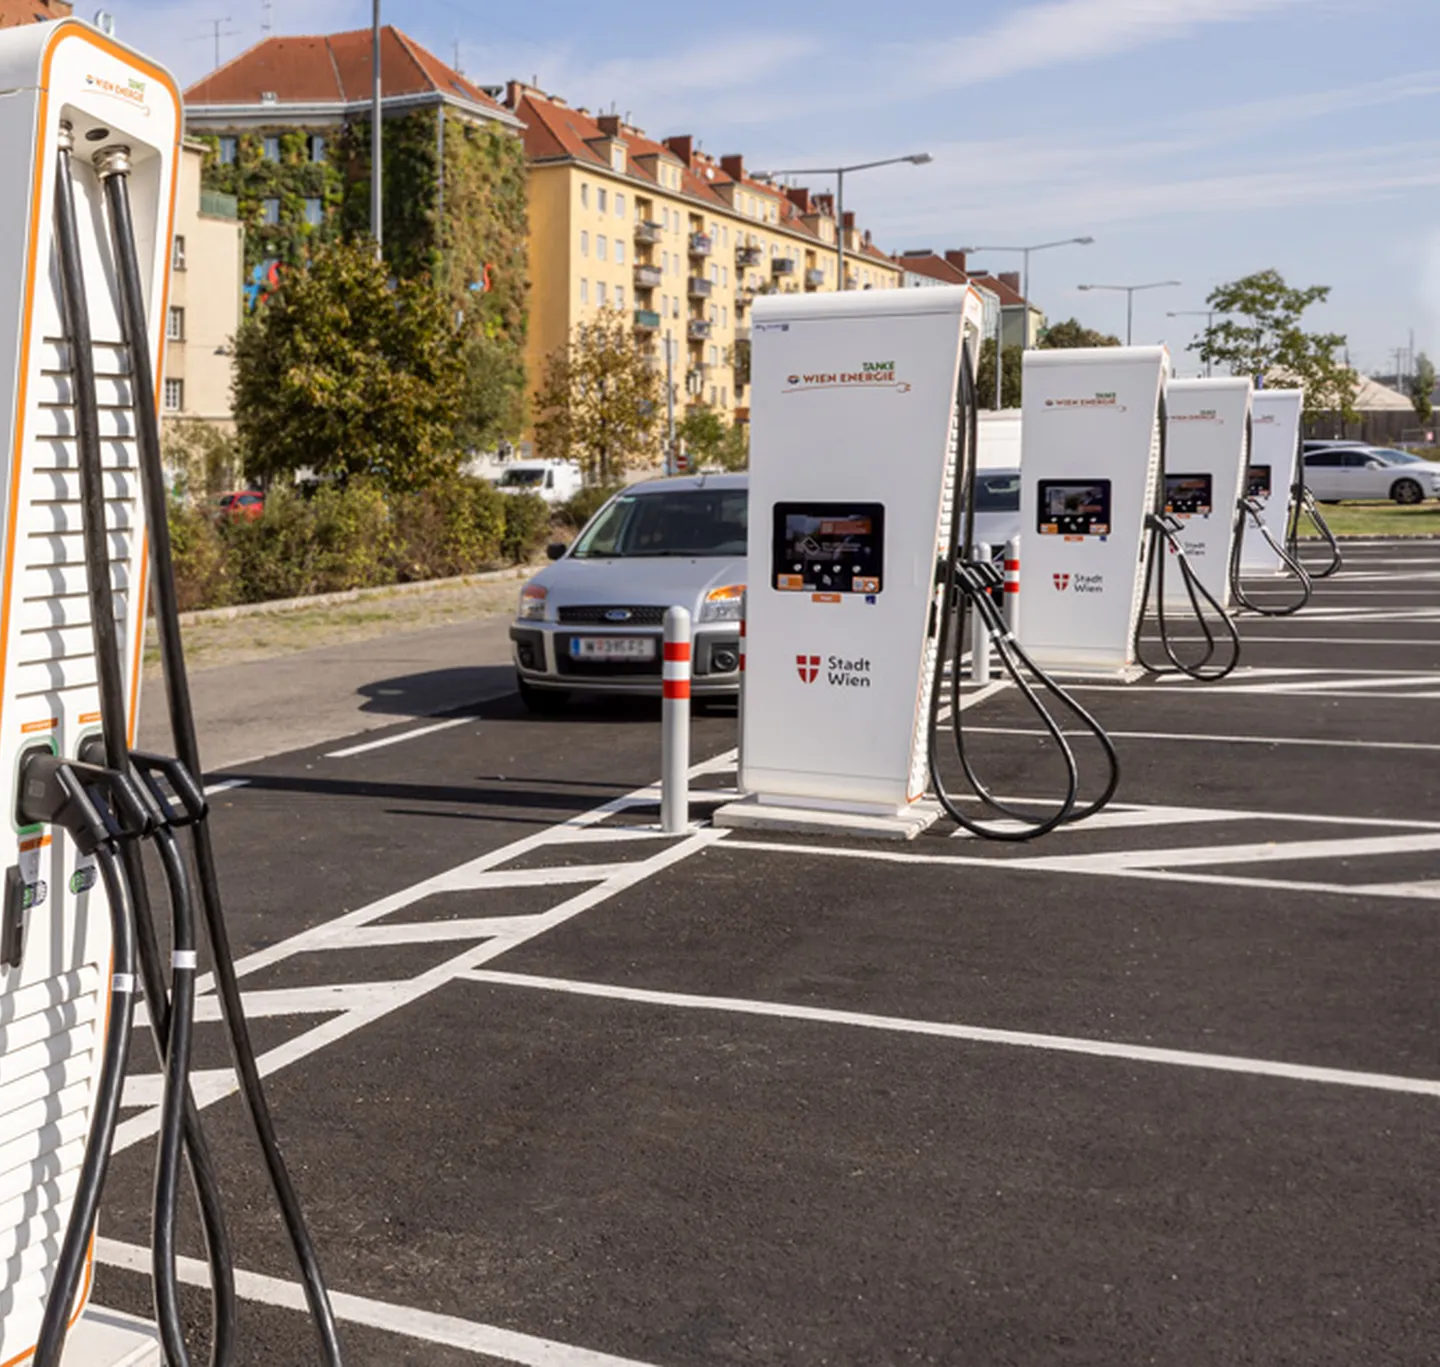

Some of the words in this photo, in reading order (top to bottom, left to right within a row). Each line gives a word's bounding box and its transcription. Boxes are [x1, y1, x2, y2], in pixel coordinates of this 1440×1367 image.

[862, 360, 896, 372] TANKE
[803, 373, 837, 384] WIEN
[840, 371, 896, 383] ENERGIE
[1073, 573, 1103, 584] Stadt
[1073, 583, 1103, 594] Wien
[827, 655, 871, 672] Stadt
[827, 671, 871, 688] Wien
